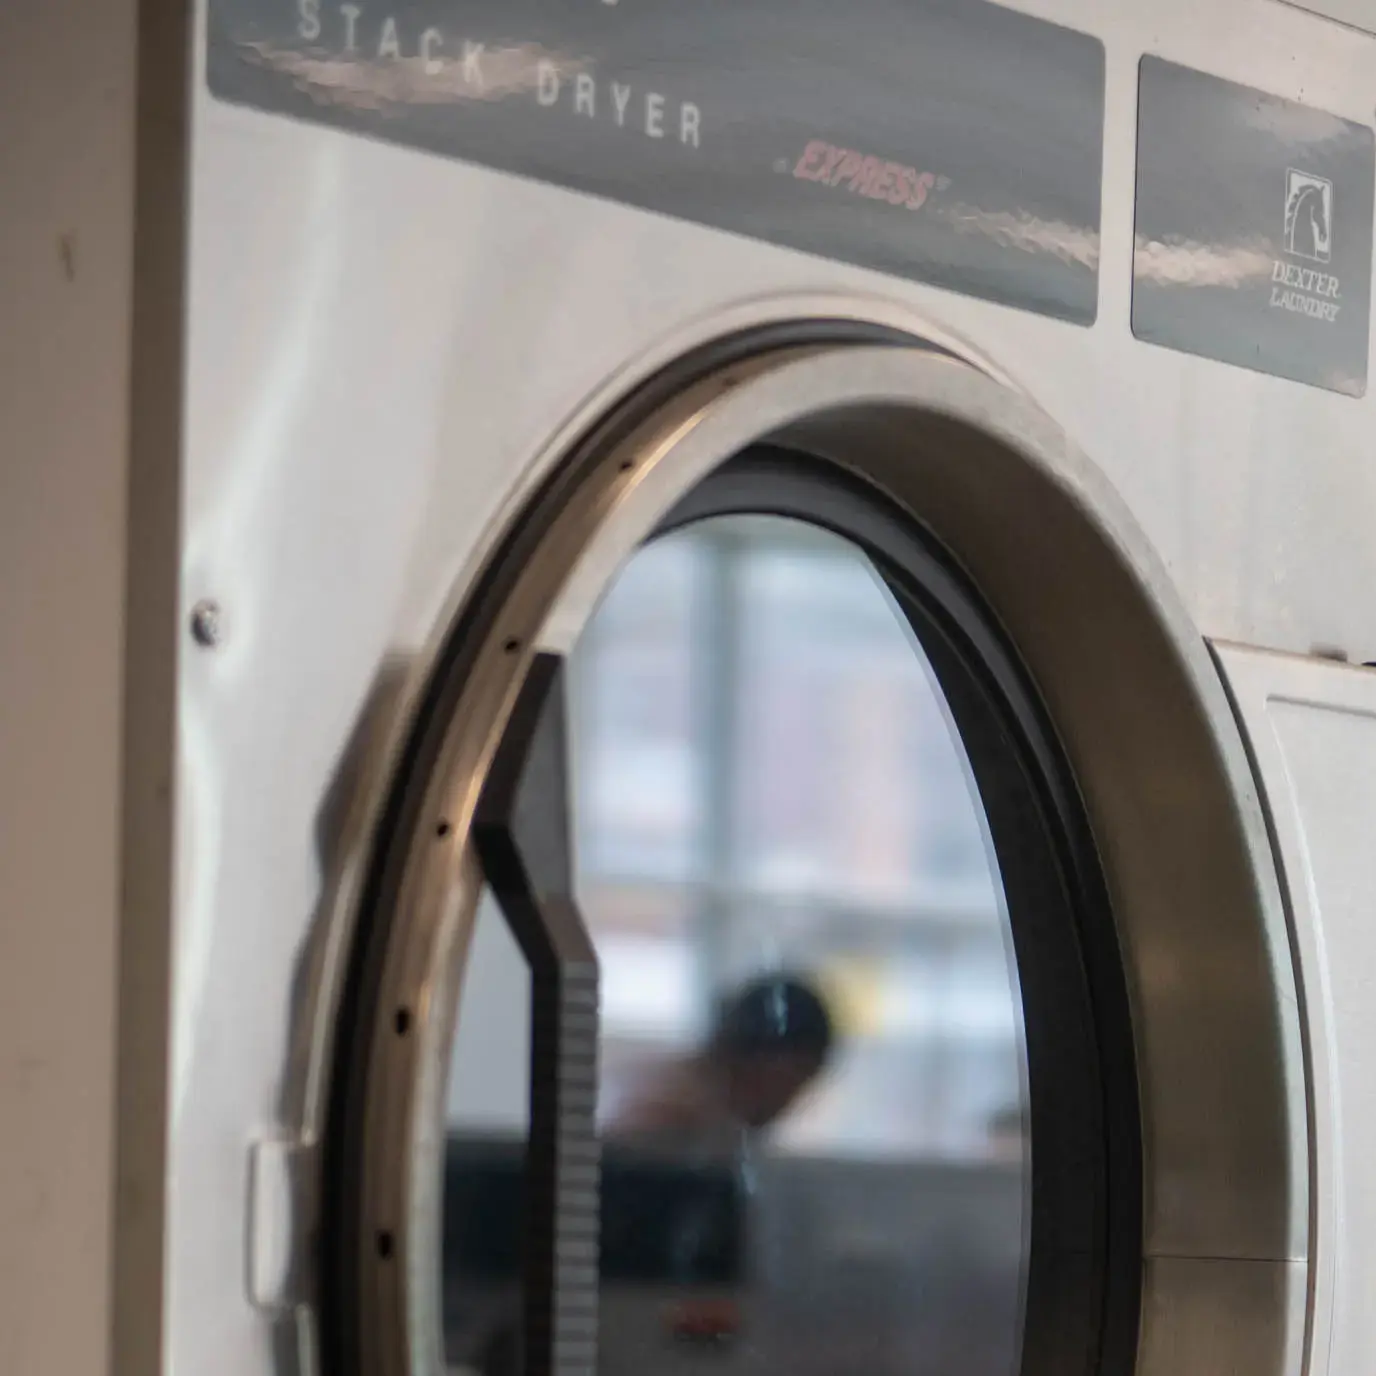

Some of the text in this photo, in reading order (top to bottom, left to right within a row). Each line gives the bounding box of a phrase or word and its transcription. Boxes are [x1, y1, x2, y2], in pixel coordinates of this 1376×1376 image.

[297, 0, 700, 148] STACK DRYER
[793, 139, 936, 211] EXPRESS
[1269, 286, 1341, 323] LAUNDRY
[1271, 260, 1341, 299] DEXTER
